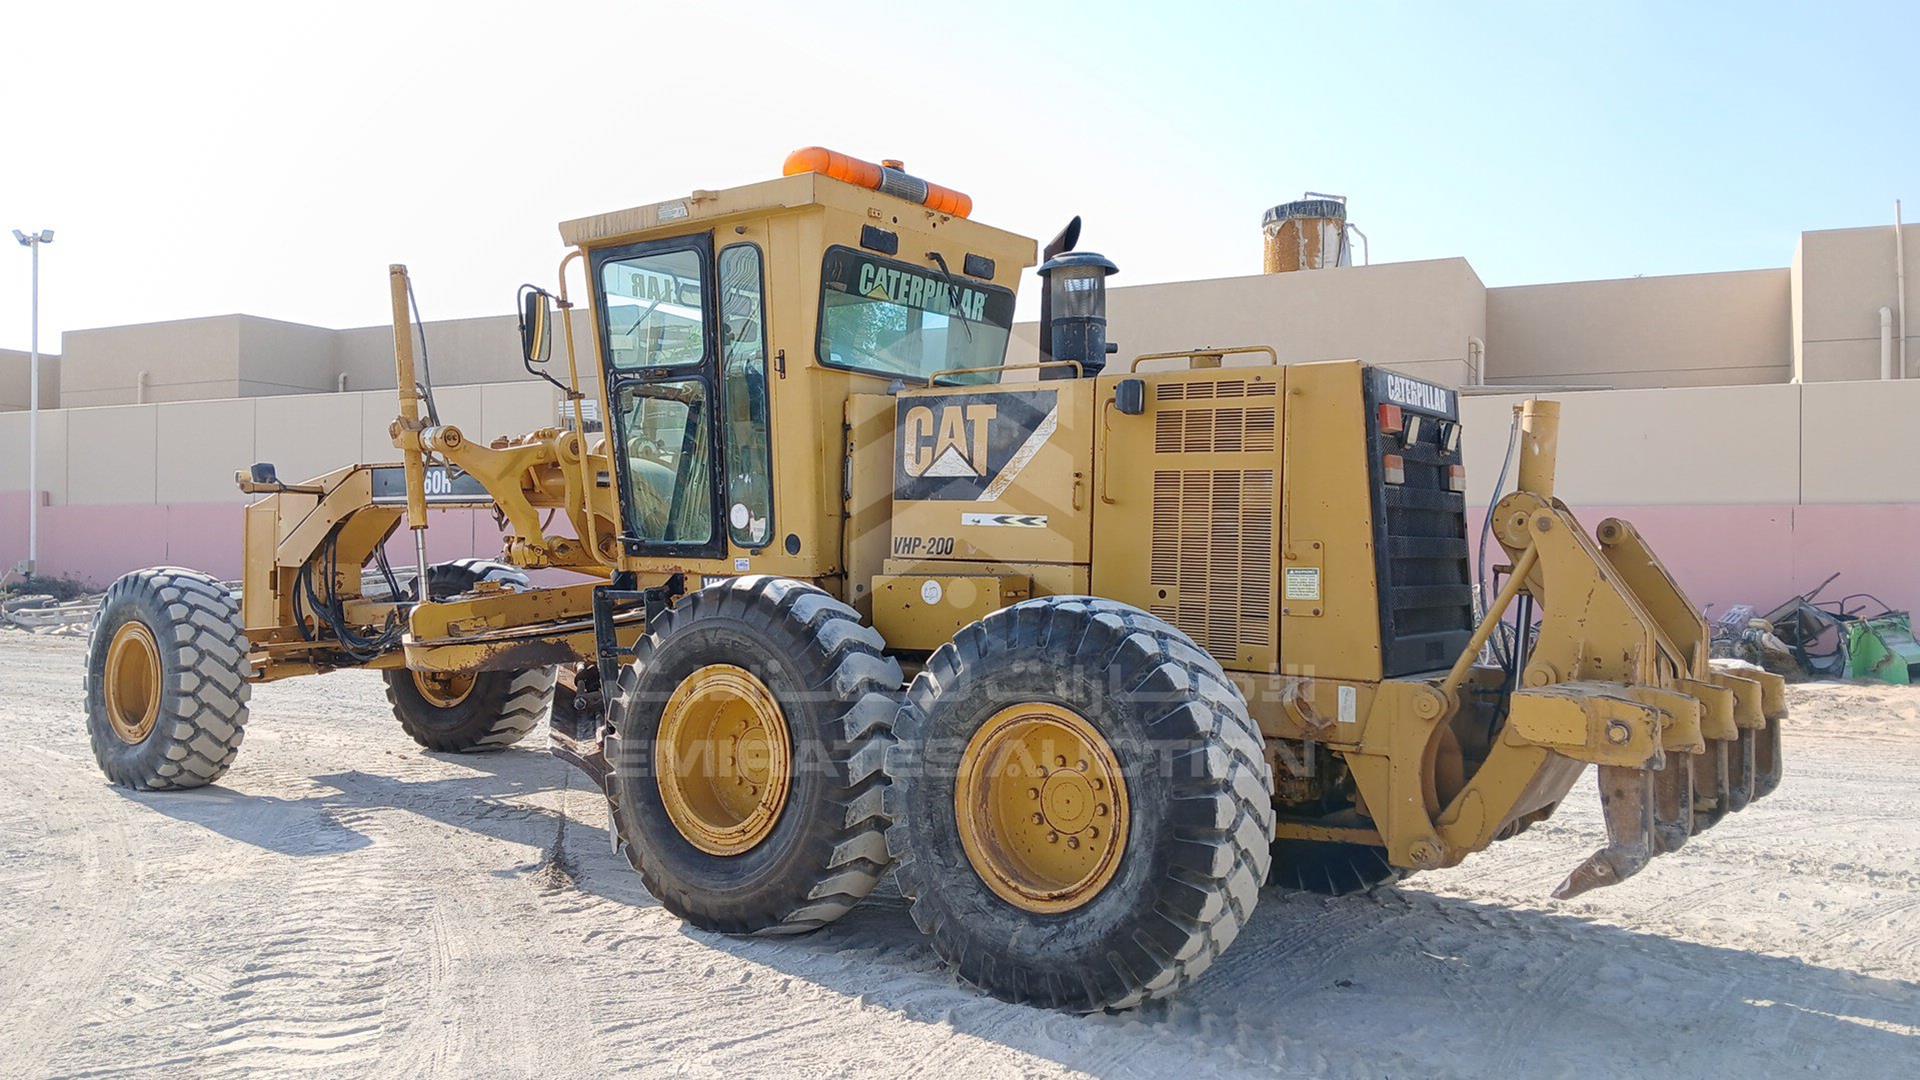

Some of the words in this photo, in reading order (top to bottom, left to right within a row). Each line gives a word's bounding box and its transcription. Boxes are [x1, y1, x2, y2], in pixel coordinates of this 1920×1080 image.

[1387, 374, 1447, 413] CATERPILLAR
[903, 404, 997, 477] CAT
[424, 470, 451, 494] 60H
[893, 536, 955, 556] VHP-200
